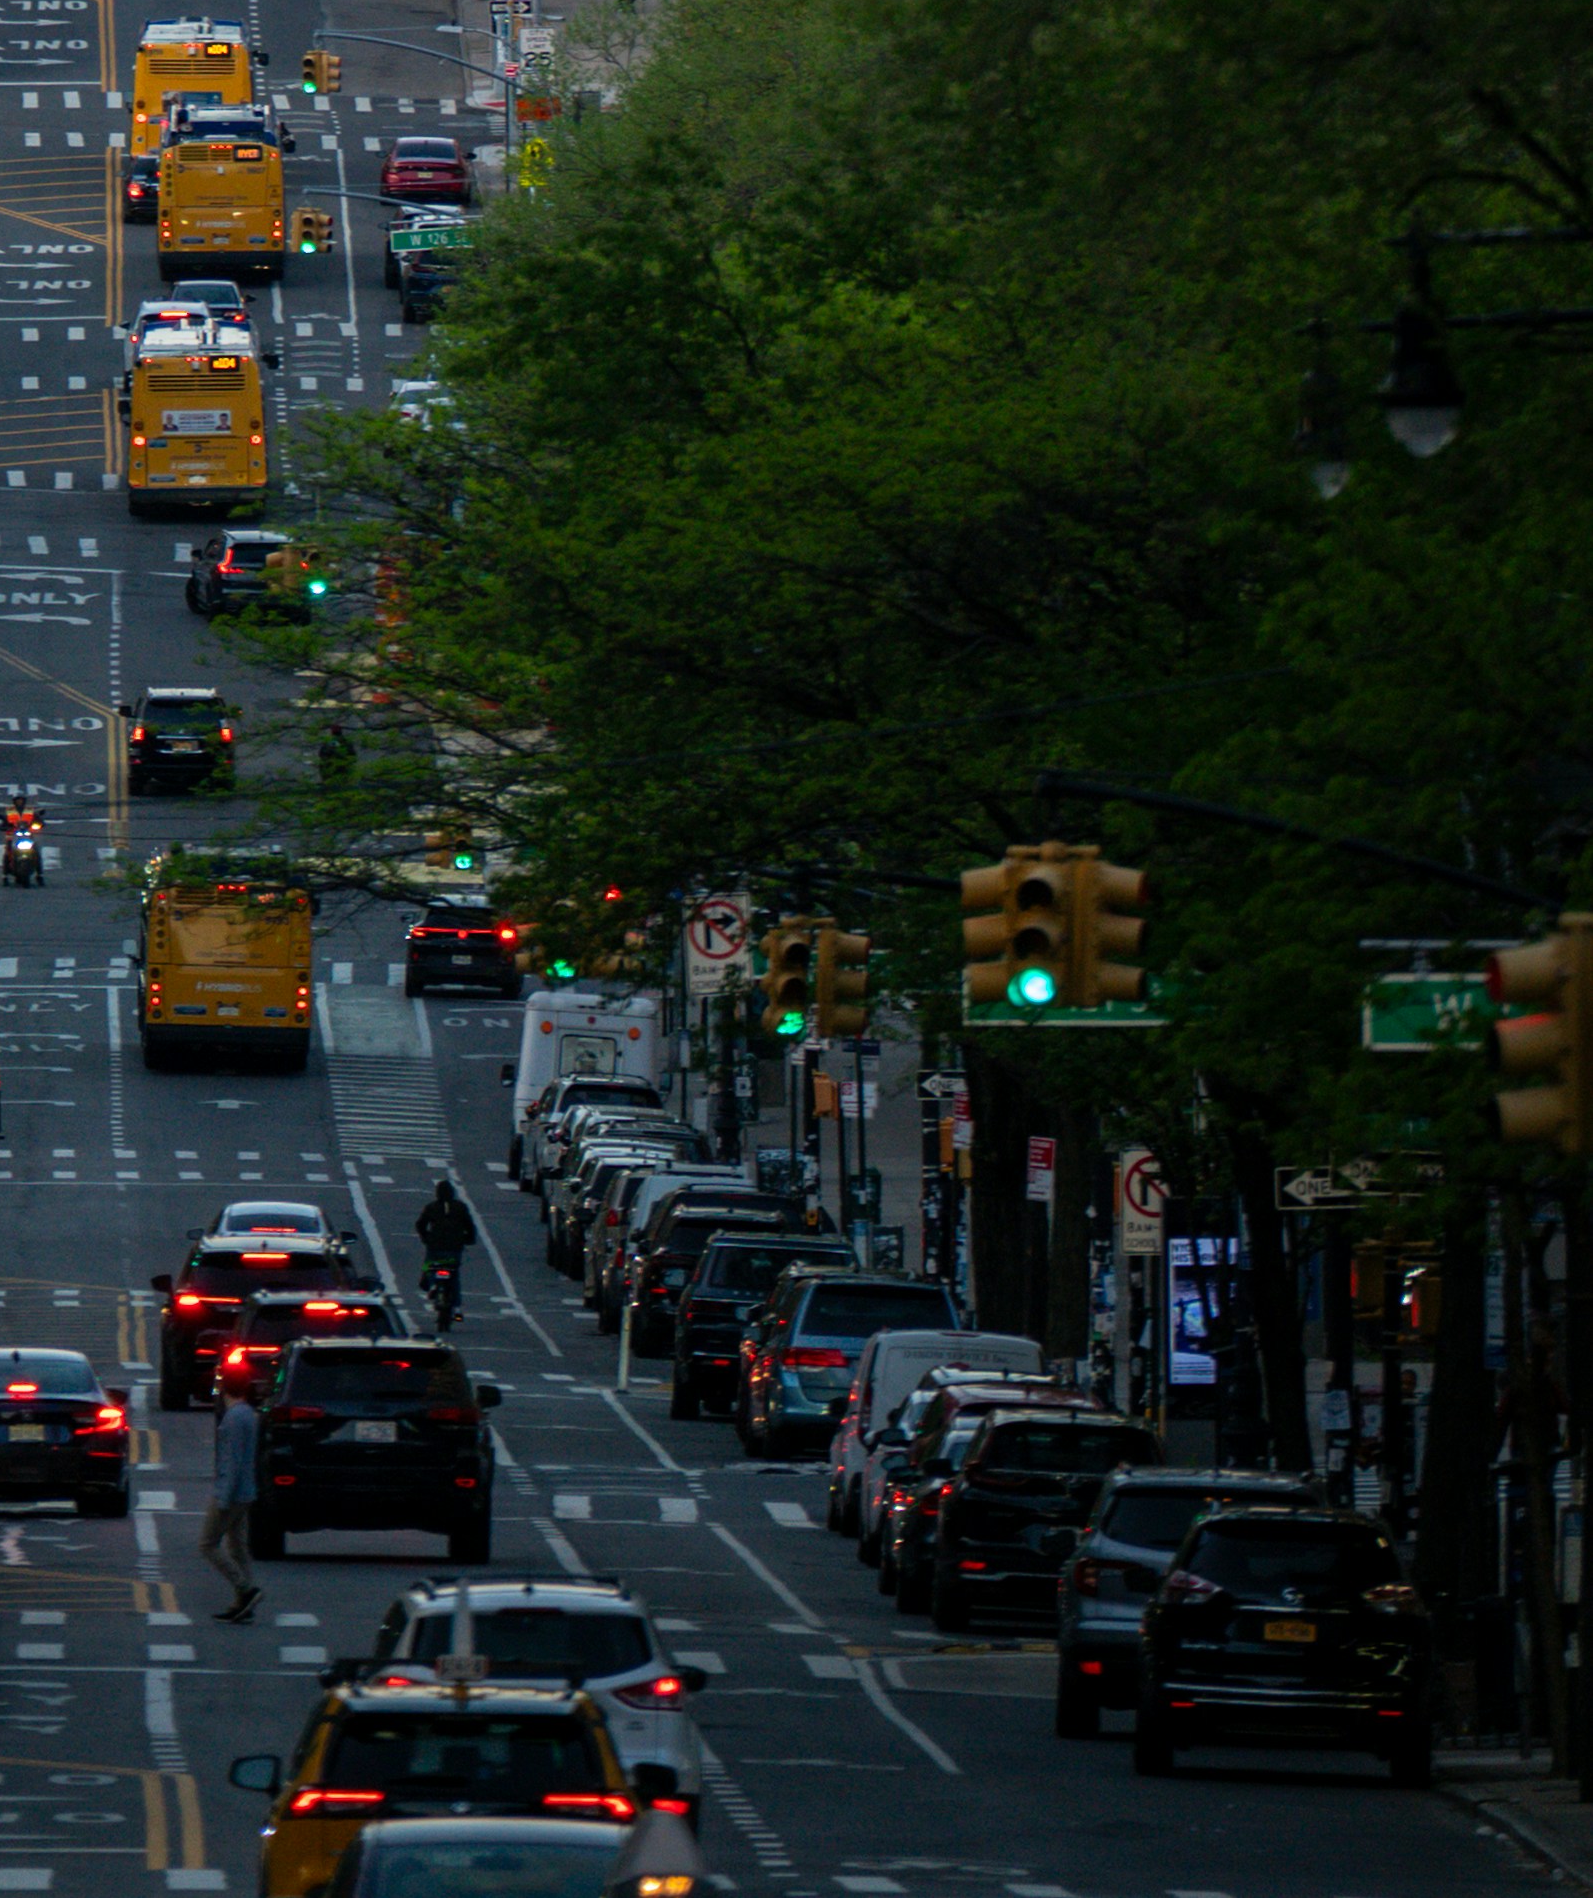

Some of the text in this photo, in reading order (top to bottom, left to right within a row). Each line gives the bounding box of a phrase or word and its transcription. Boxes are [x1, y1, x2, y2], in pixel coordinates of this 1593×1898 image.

[524, 52, 552, 68] 25
[410, 234, 423, 246] W
[1295, 1180, 1329, 1196] ONE
